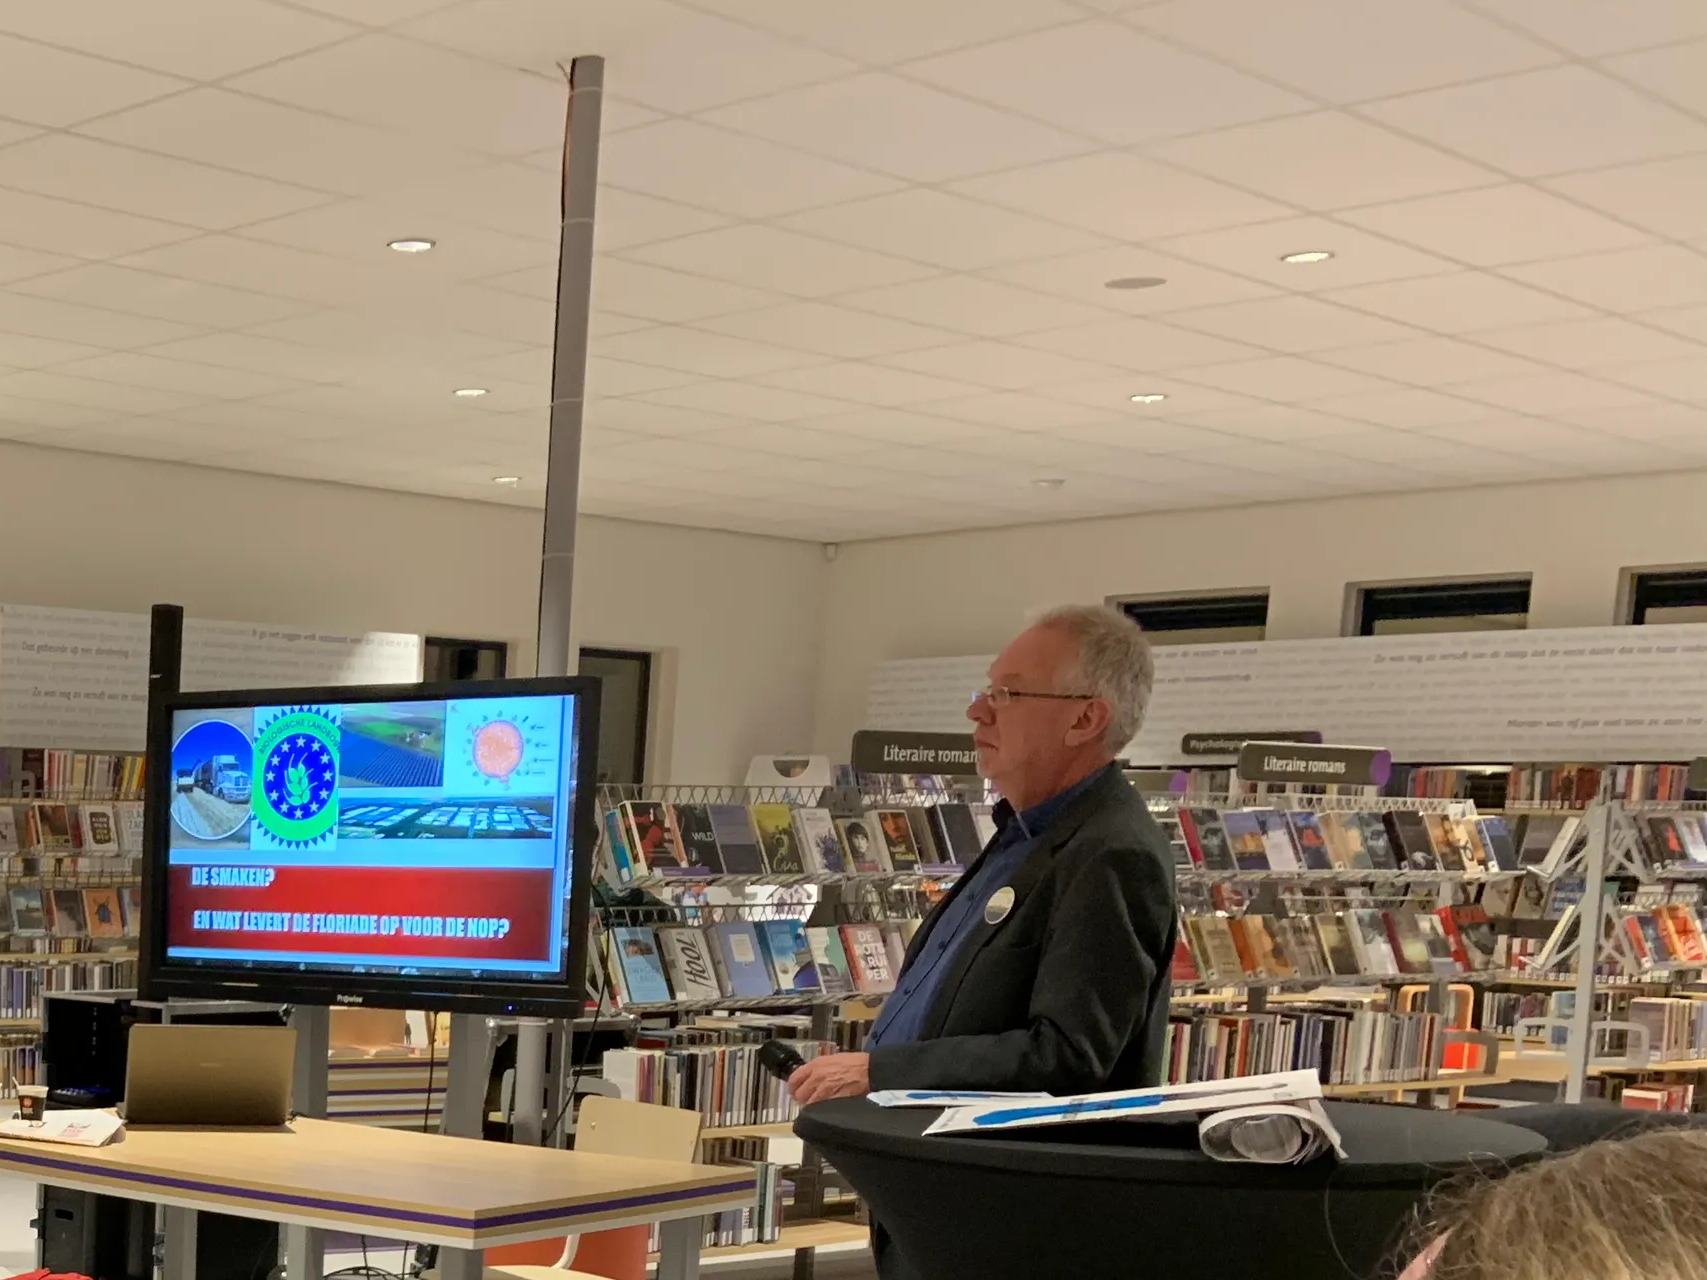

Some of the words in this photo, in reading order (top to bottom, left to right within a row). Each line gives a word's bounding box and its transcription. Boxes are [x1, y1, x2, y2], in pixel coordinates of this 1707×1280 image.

[884, 744, 936, 763] Literaire
[1263, 754, 1306, 774] Literaire
[1307, 756, 1348, 774] romans
[691, 831, 715, 842] WILD
[191, 866, 209, 888] DE
[209, 867, 275, 889] SMAKEN?
[193, 909, 211, 929] EN
[212, 910, 242, 931] WAT
[243, 911, 291, 933] LEVERT
[293, 912, 312, 933] DE
[313, 912, 378, 936] FLORIADE
[379, 915, 400, 937] OP
[401, 916, 445, 938] VOOR
[446, 917, 466, 938] DE
[467, 918, 511, 939] NOP?
[858, 930, 874, 942] DE
[676, 938, 718, 990] HOOL
